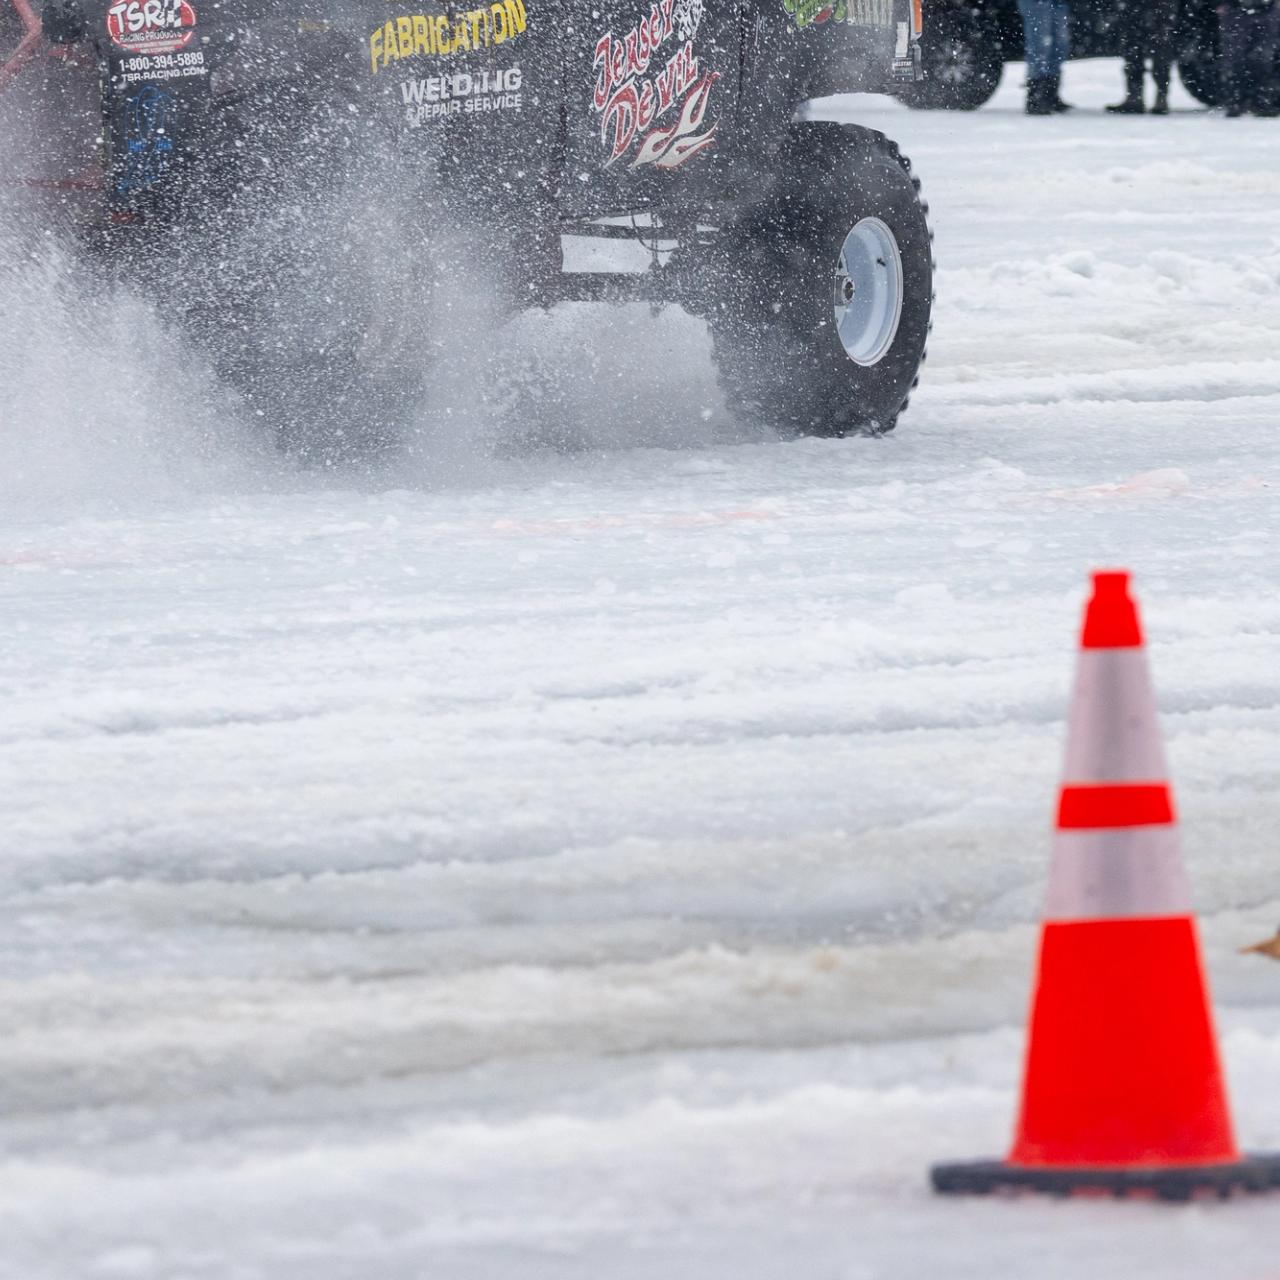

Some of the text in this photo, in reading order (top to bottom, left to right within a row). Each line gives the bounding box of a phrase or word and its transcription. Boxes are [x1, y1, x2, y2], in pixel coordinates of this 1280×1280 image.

[109, 0, 166, 33] TSR
[118, 51, 205, 73] 1-800-394-5889
[121, 66, 207, 82] TSR-RACING.COM
[400, 68, 522, 105] WELDING
[417, 98, 461, 120] REPAIR
[464, 93, 522, 114] SERVICE
